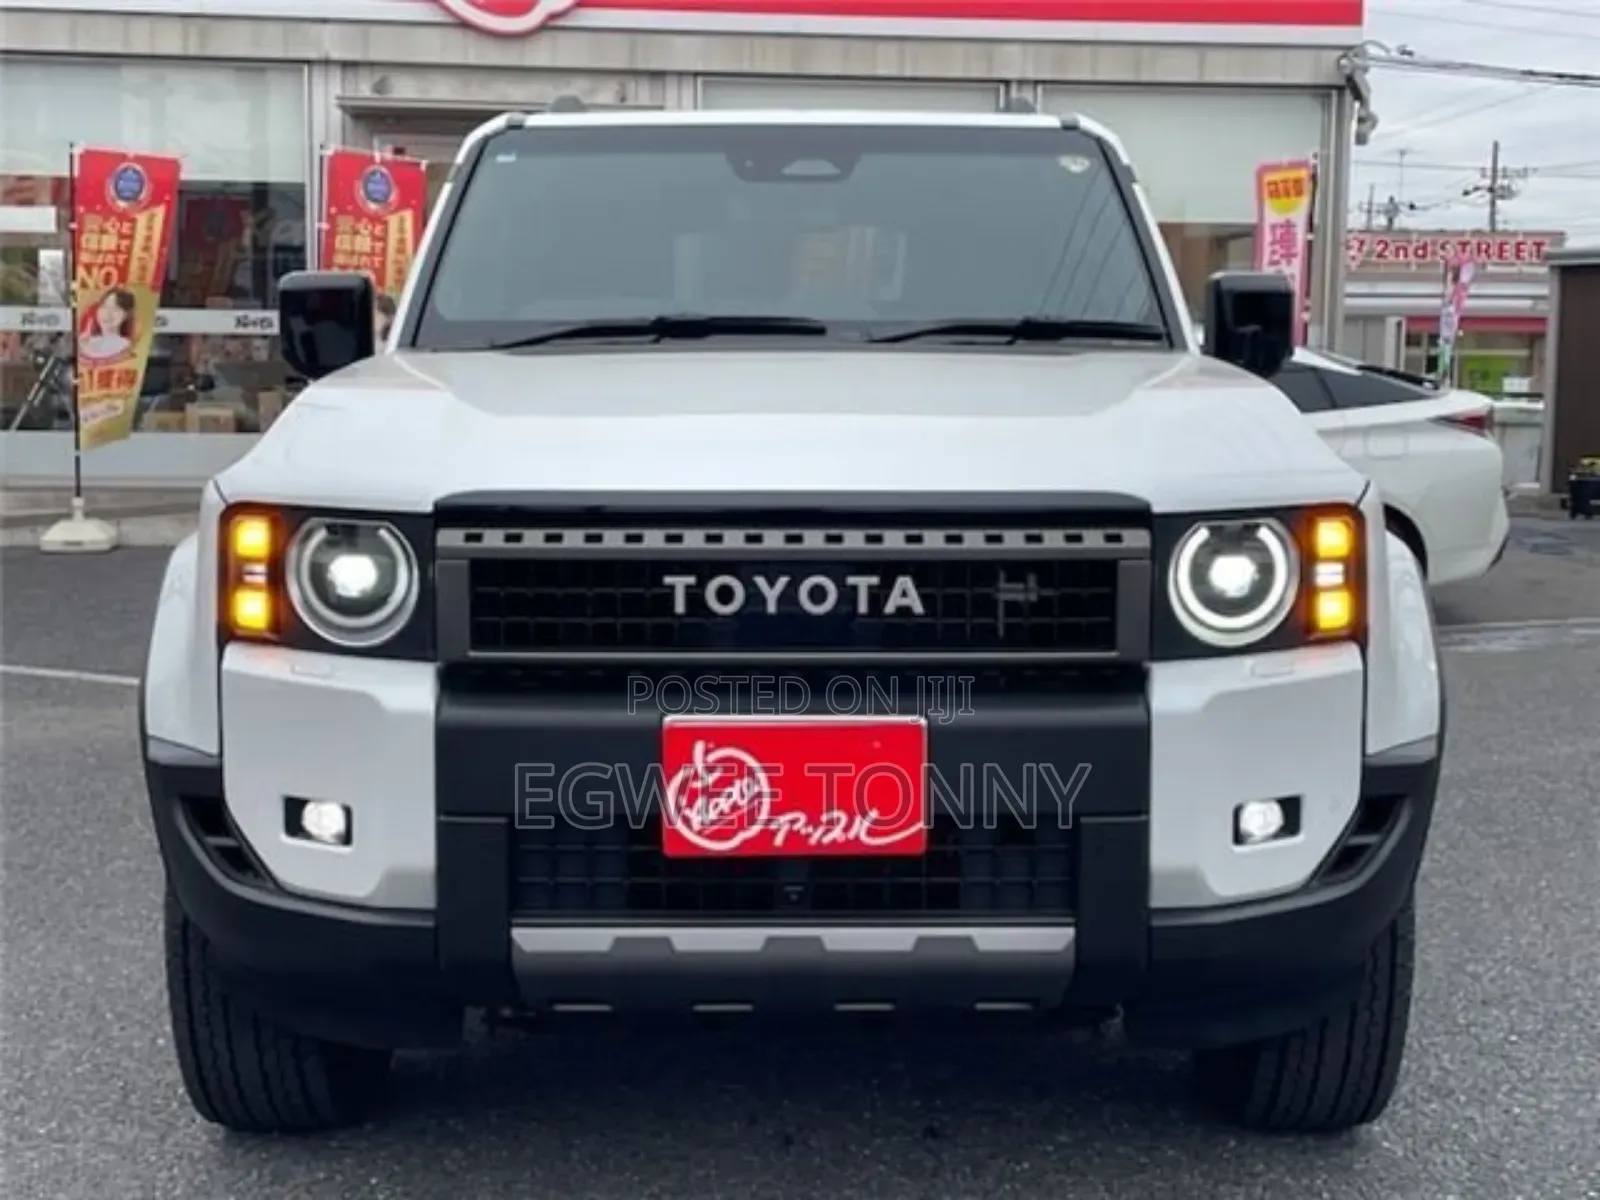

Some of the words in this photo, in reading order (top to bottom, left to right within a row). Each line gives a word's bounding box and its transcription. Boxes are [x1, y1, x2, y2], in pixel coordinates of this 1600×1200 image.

[1375, 240, 1430, 260] 2nd
[1439, 239, 1547, 262] STREET
[663, 575, 926, 616] TOYOTA
